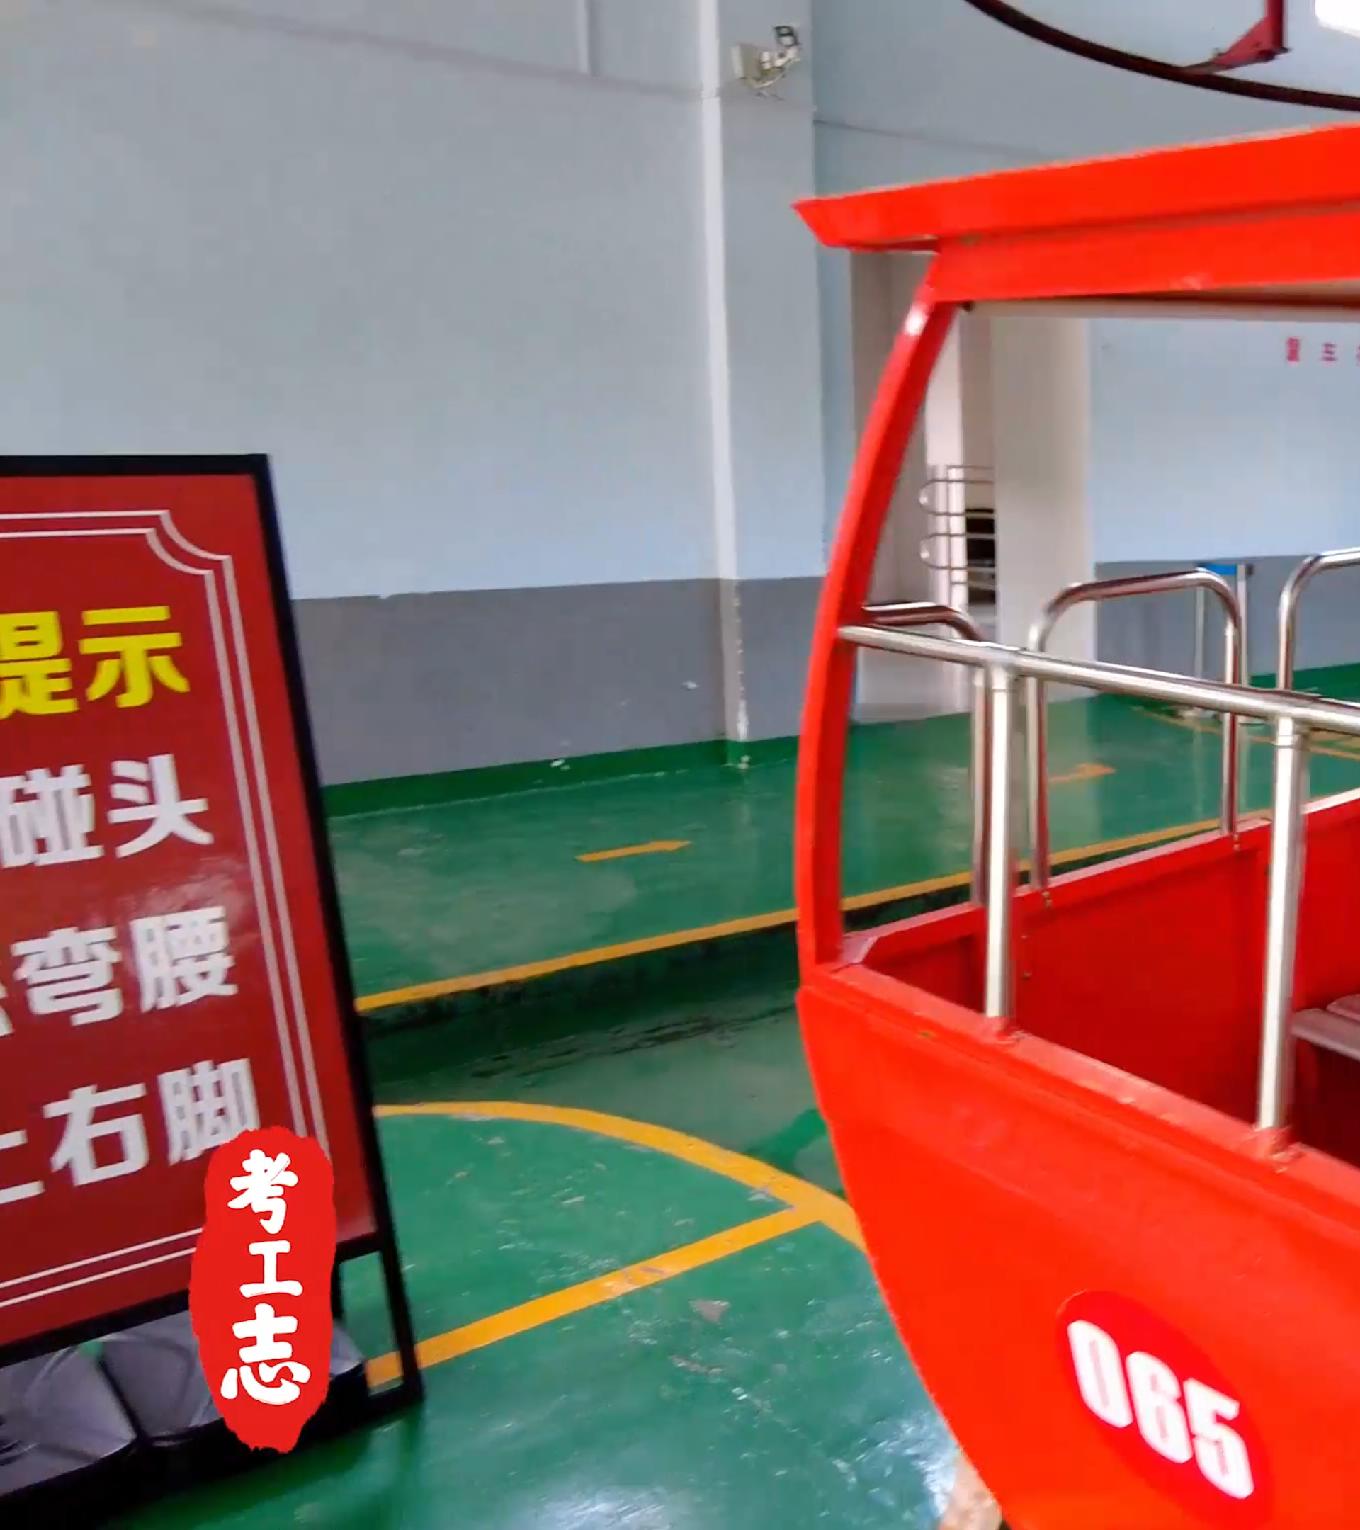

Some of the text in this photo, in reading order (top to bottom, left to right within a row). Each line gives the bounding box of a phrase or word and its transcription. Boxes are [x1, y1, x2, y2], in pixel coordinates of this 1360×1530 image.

[0, 605, 190, 720] 提示
[0, 753, 215, 868] 碰头
[0, 906, 238, 1037] 弯腰
[1066, 1319, 1255, 1500] 065
